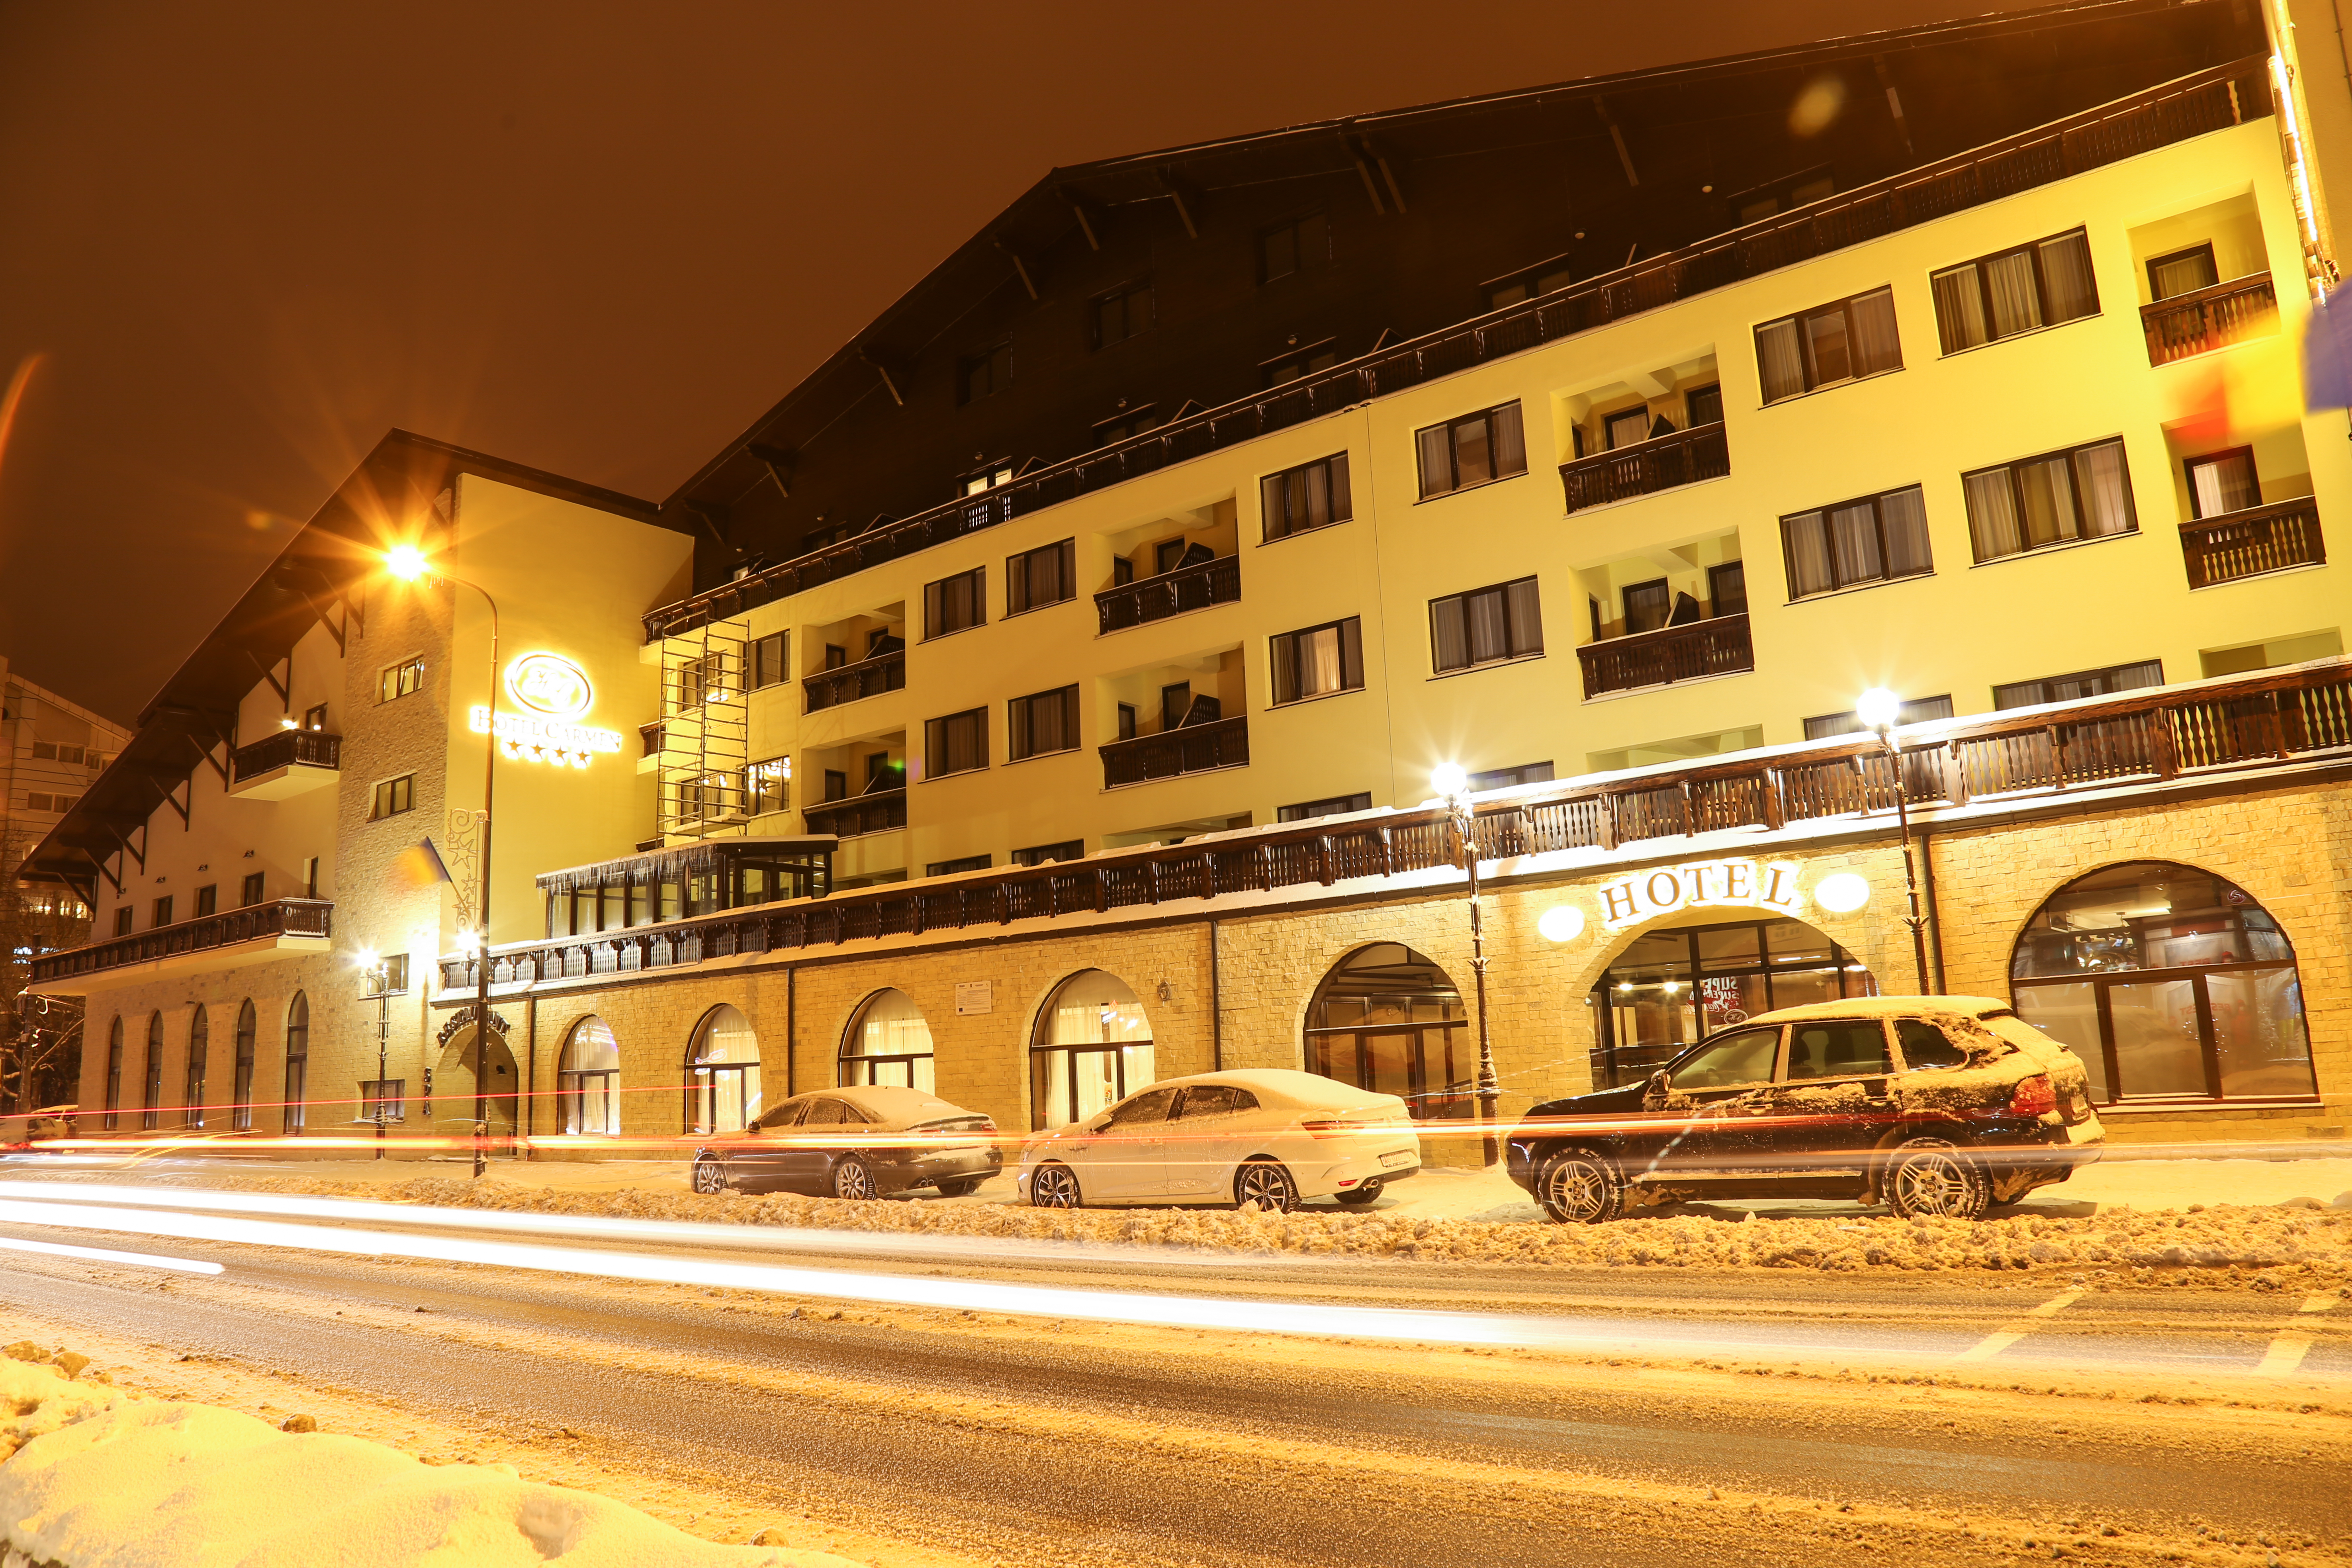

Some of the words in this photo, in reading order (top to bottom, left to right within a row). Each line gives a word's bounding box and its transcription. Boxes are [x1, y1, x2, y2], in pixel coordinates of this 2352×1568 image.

[478, 710, 540, 736] HOTEL
[545, 722, 621, 749] CARMEN
[1601, 864, 1792, 922] HOTEL
[422, 1066, 431, 1115] SPA
